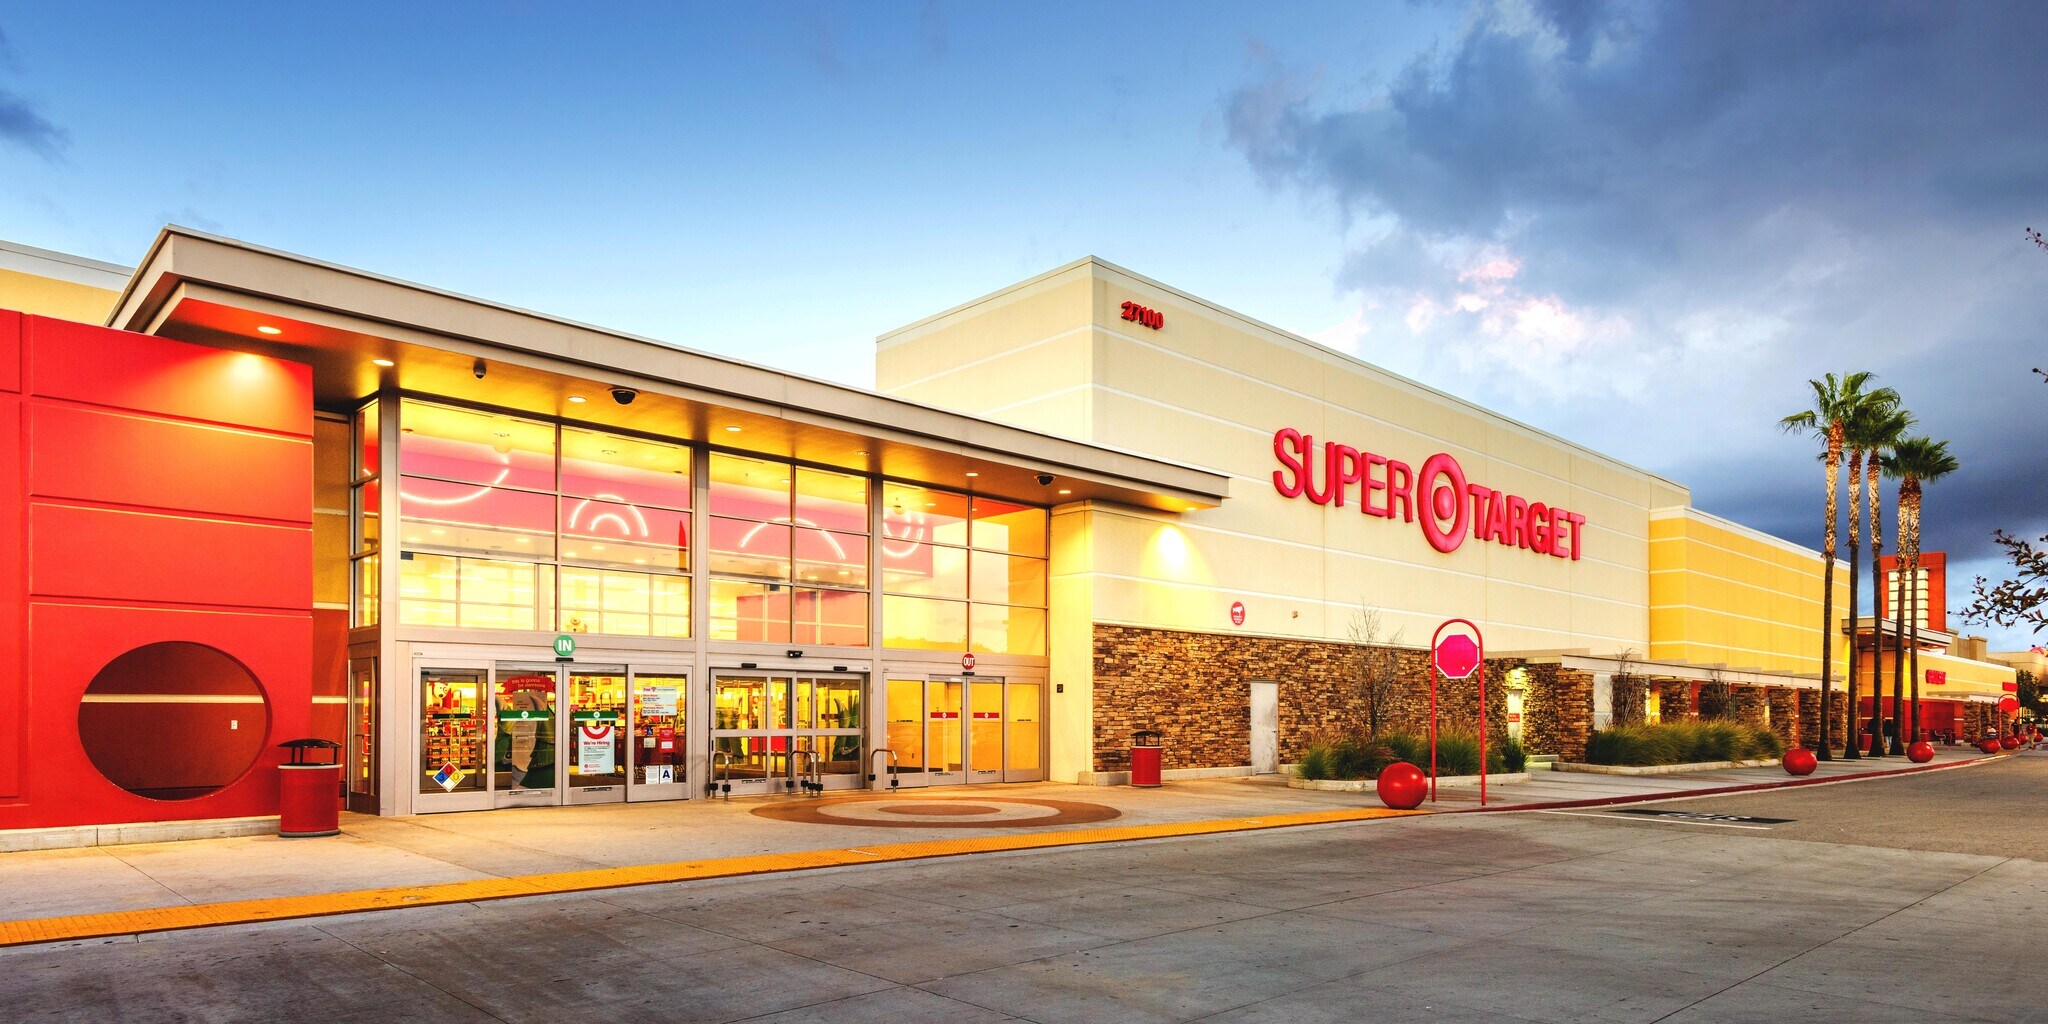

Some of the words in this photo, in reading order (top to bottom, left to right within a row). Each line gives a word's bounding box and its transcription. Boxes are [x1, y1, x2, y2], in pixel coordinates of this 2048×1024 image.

[1121, 301, 1164, 330] 27100
[1273, 428, 1413, 523] SUPER
[1468, 483, 1586, 561] TARGET
[558, 639, 572, 652] IN
[963, 657, 975, 667] OUT
[453, 772, 459, 781] 0
[662, 769, 671, 779] A
